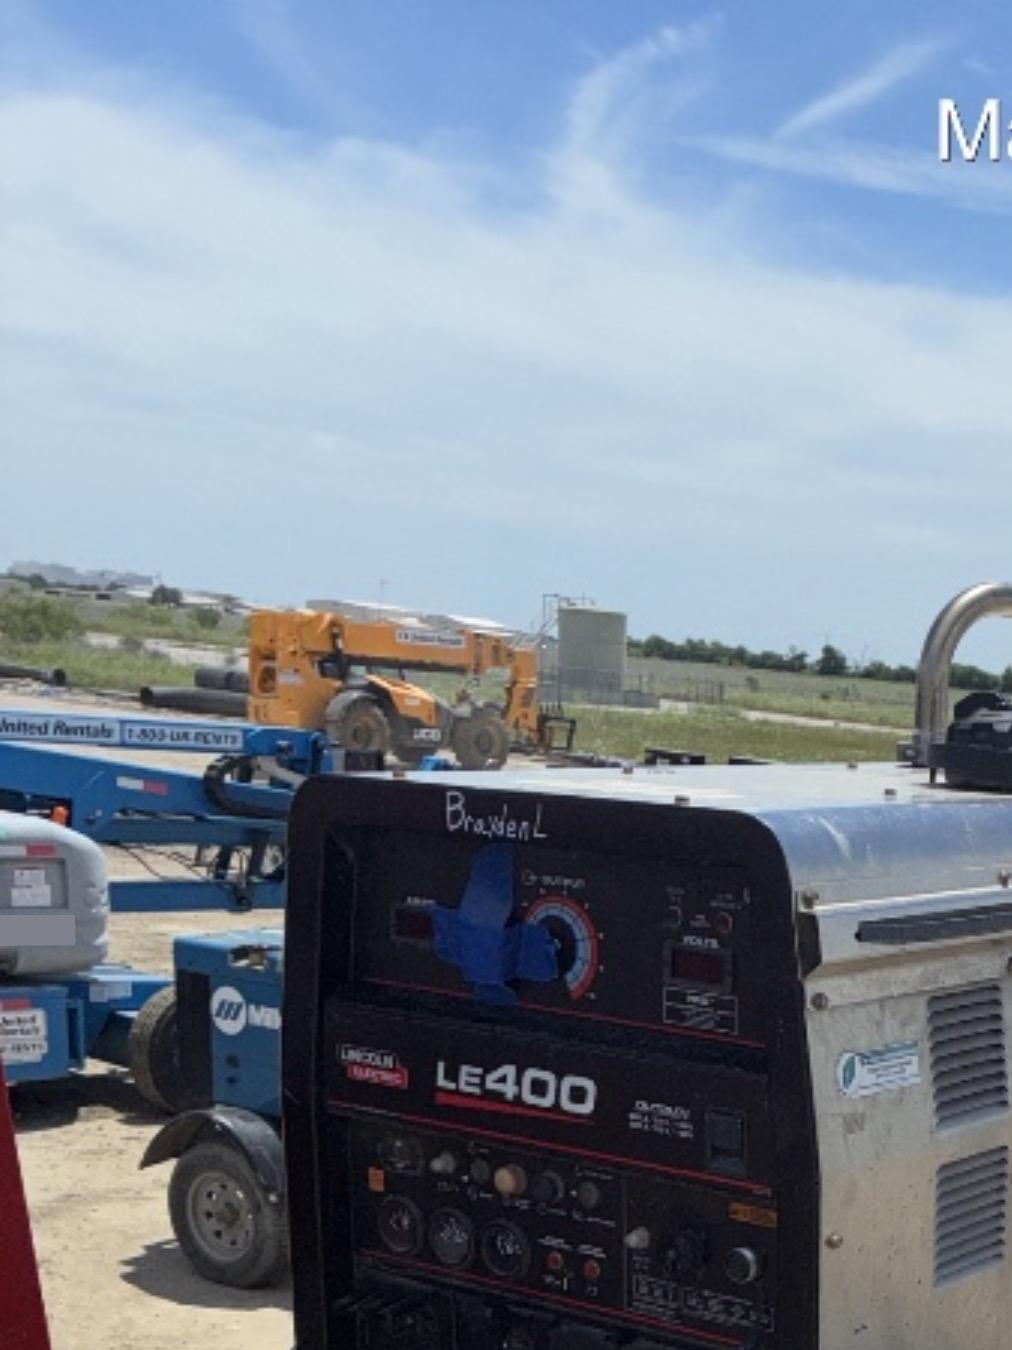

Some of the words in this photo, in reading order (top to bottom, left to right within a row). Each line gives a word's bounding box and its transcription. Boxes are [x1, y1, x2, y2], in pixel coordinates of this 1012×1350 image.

[53, 719, 112, 739] Rentals
[533, 803, 548, 838] L
[435, 1060, 598, 1115] LE400
